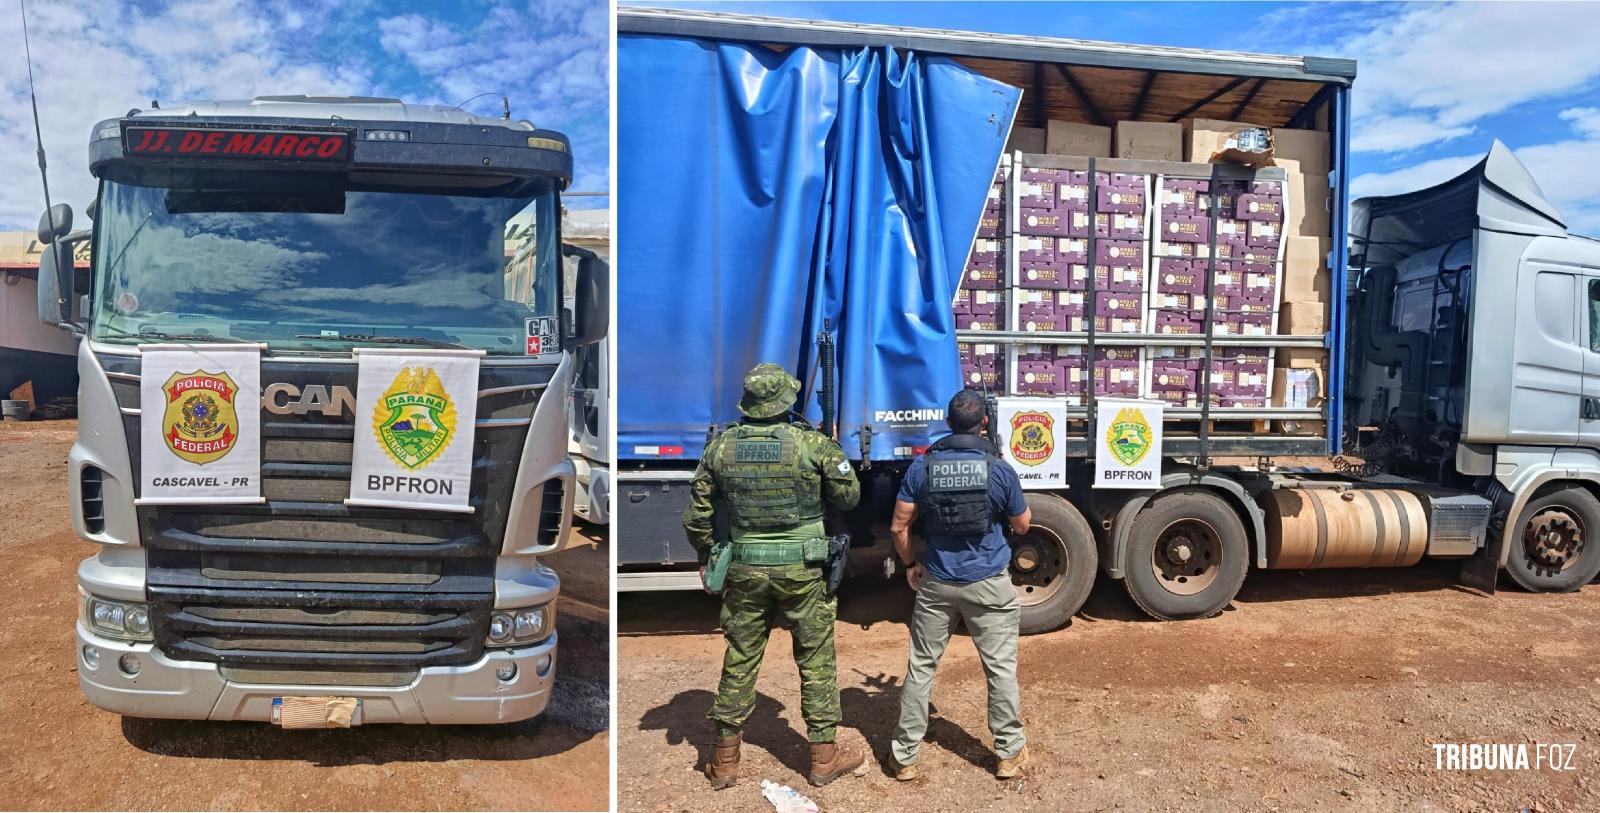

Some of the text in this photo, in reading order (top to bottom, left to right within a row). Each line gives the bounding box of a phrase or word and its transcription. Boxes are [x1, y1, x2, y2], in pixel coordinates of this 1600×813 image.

[177, 132, 225, 154] DE
[223, 133, 344, 158] MARCO
[260, 382, 356, 416] CAN
[874, 409, 944, 422] FACCHINI
[174, 437, 227, 452] FEDERAL
[416, 431, 444, 460] MILITAR
[737, 451, 779, 460] BPFRON
[1016, 450, 1048, 459] FEDERAL
[1049, 472, 1060, 480] PR
[1104, 470, 1152, 481] BPFRON
[152, 477, 220, 487] CASCAVEL
[231, 477, 249, 487] PR
[367, 474, 453, 496] BPFRON
[932, 476, 985, 488] FEDERAL
